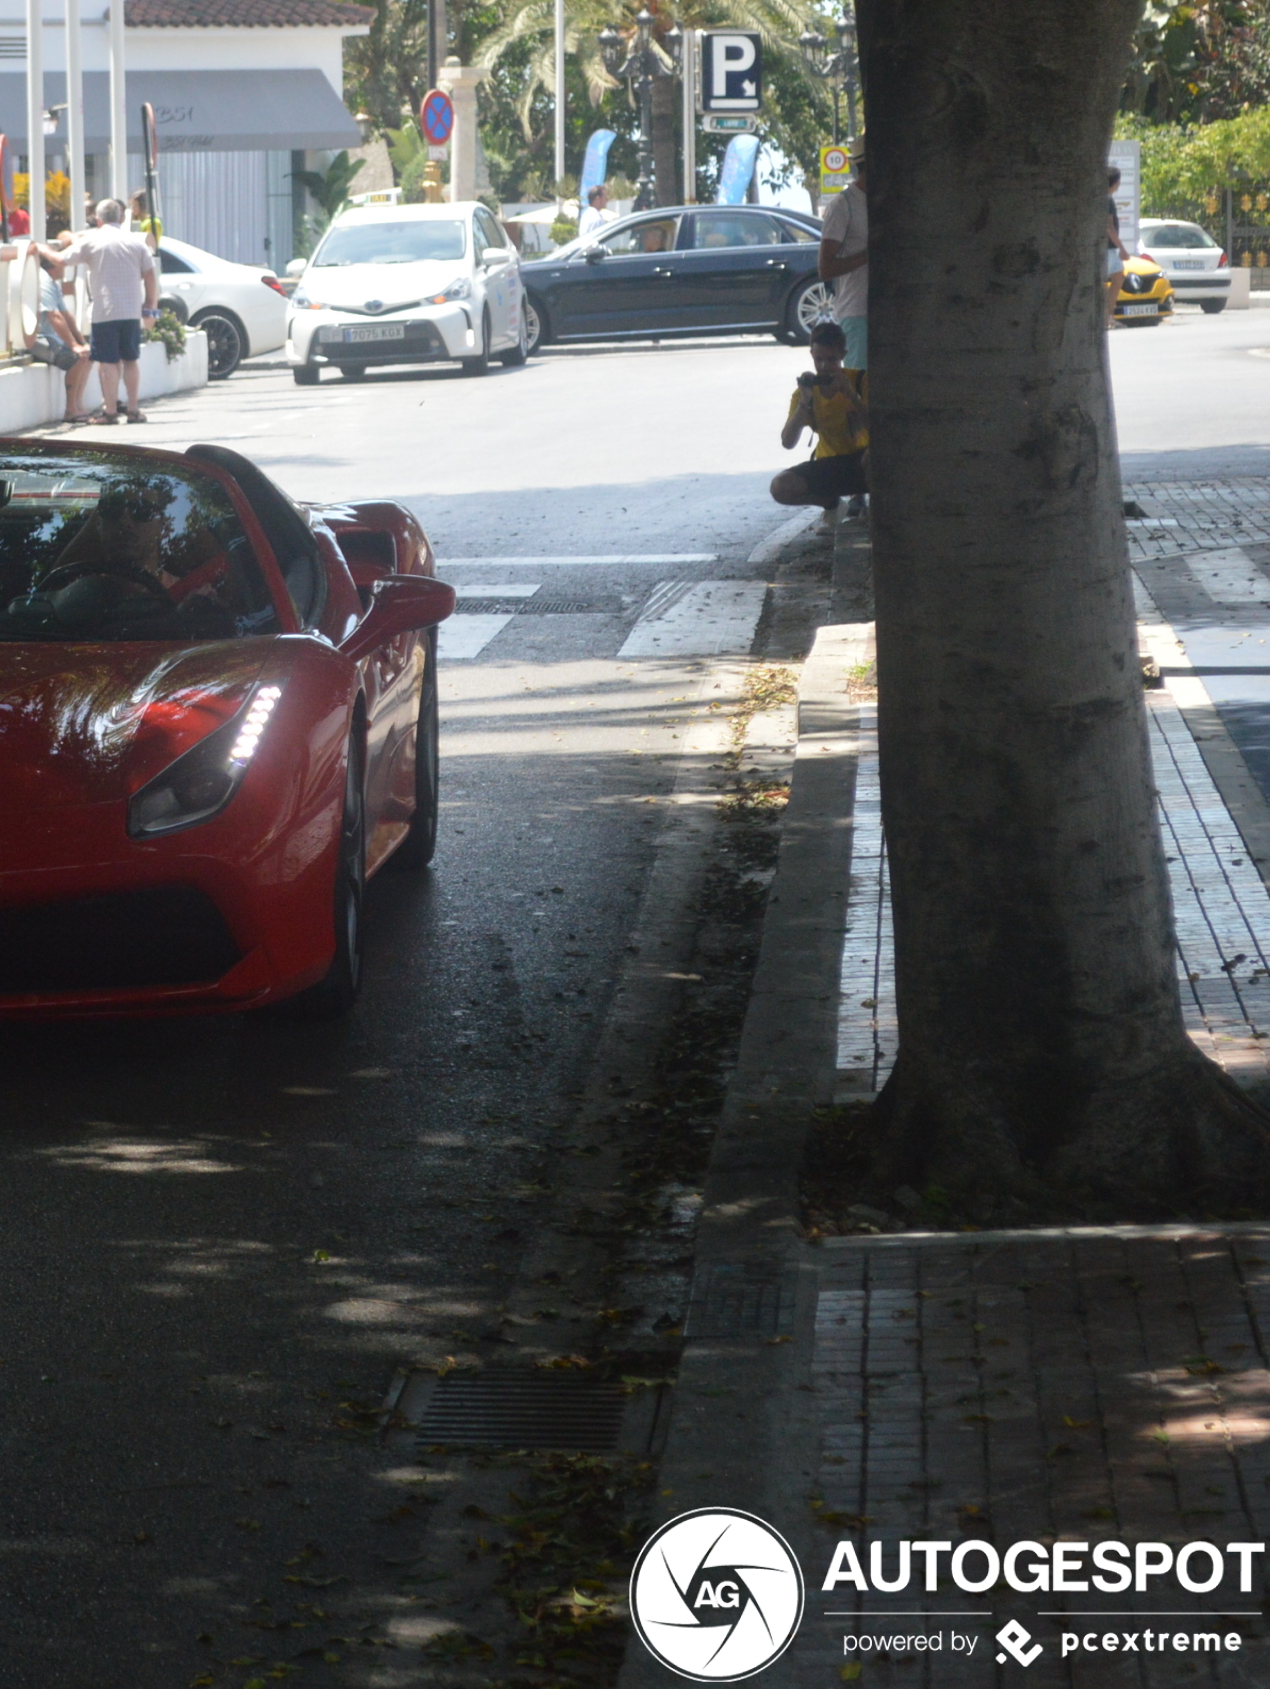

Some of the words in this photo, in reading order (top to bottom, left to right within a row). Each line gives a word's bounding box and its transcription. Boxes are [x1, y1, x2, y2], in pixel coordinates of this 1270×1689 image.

[712, 35, 756, 97] P
[830, 156, 842, 165] 10
[352, 329, 379, 340] 7075
[381, 327, 403, 338] KGX
